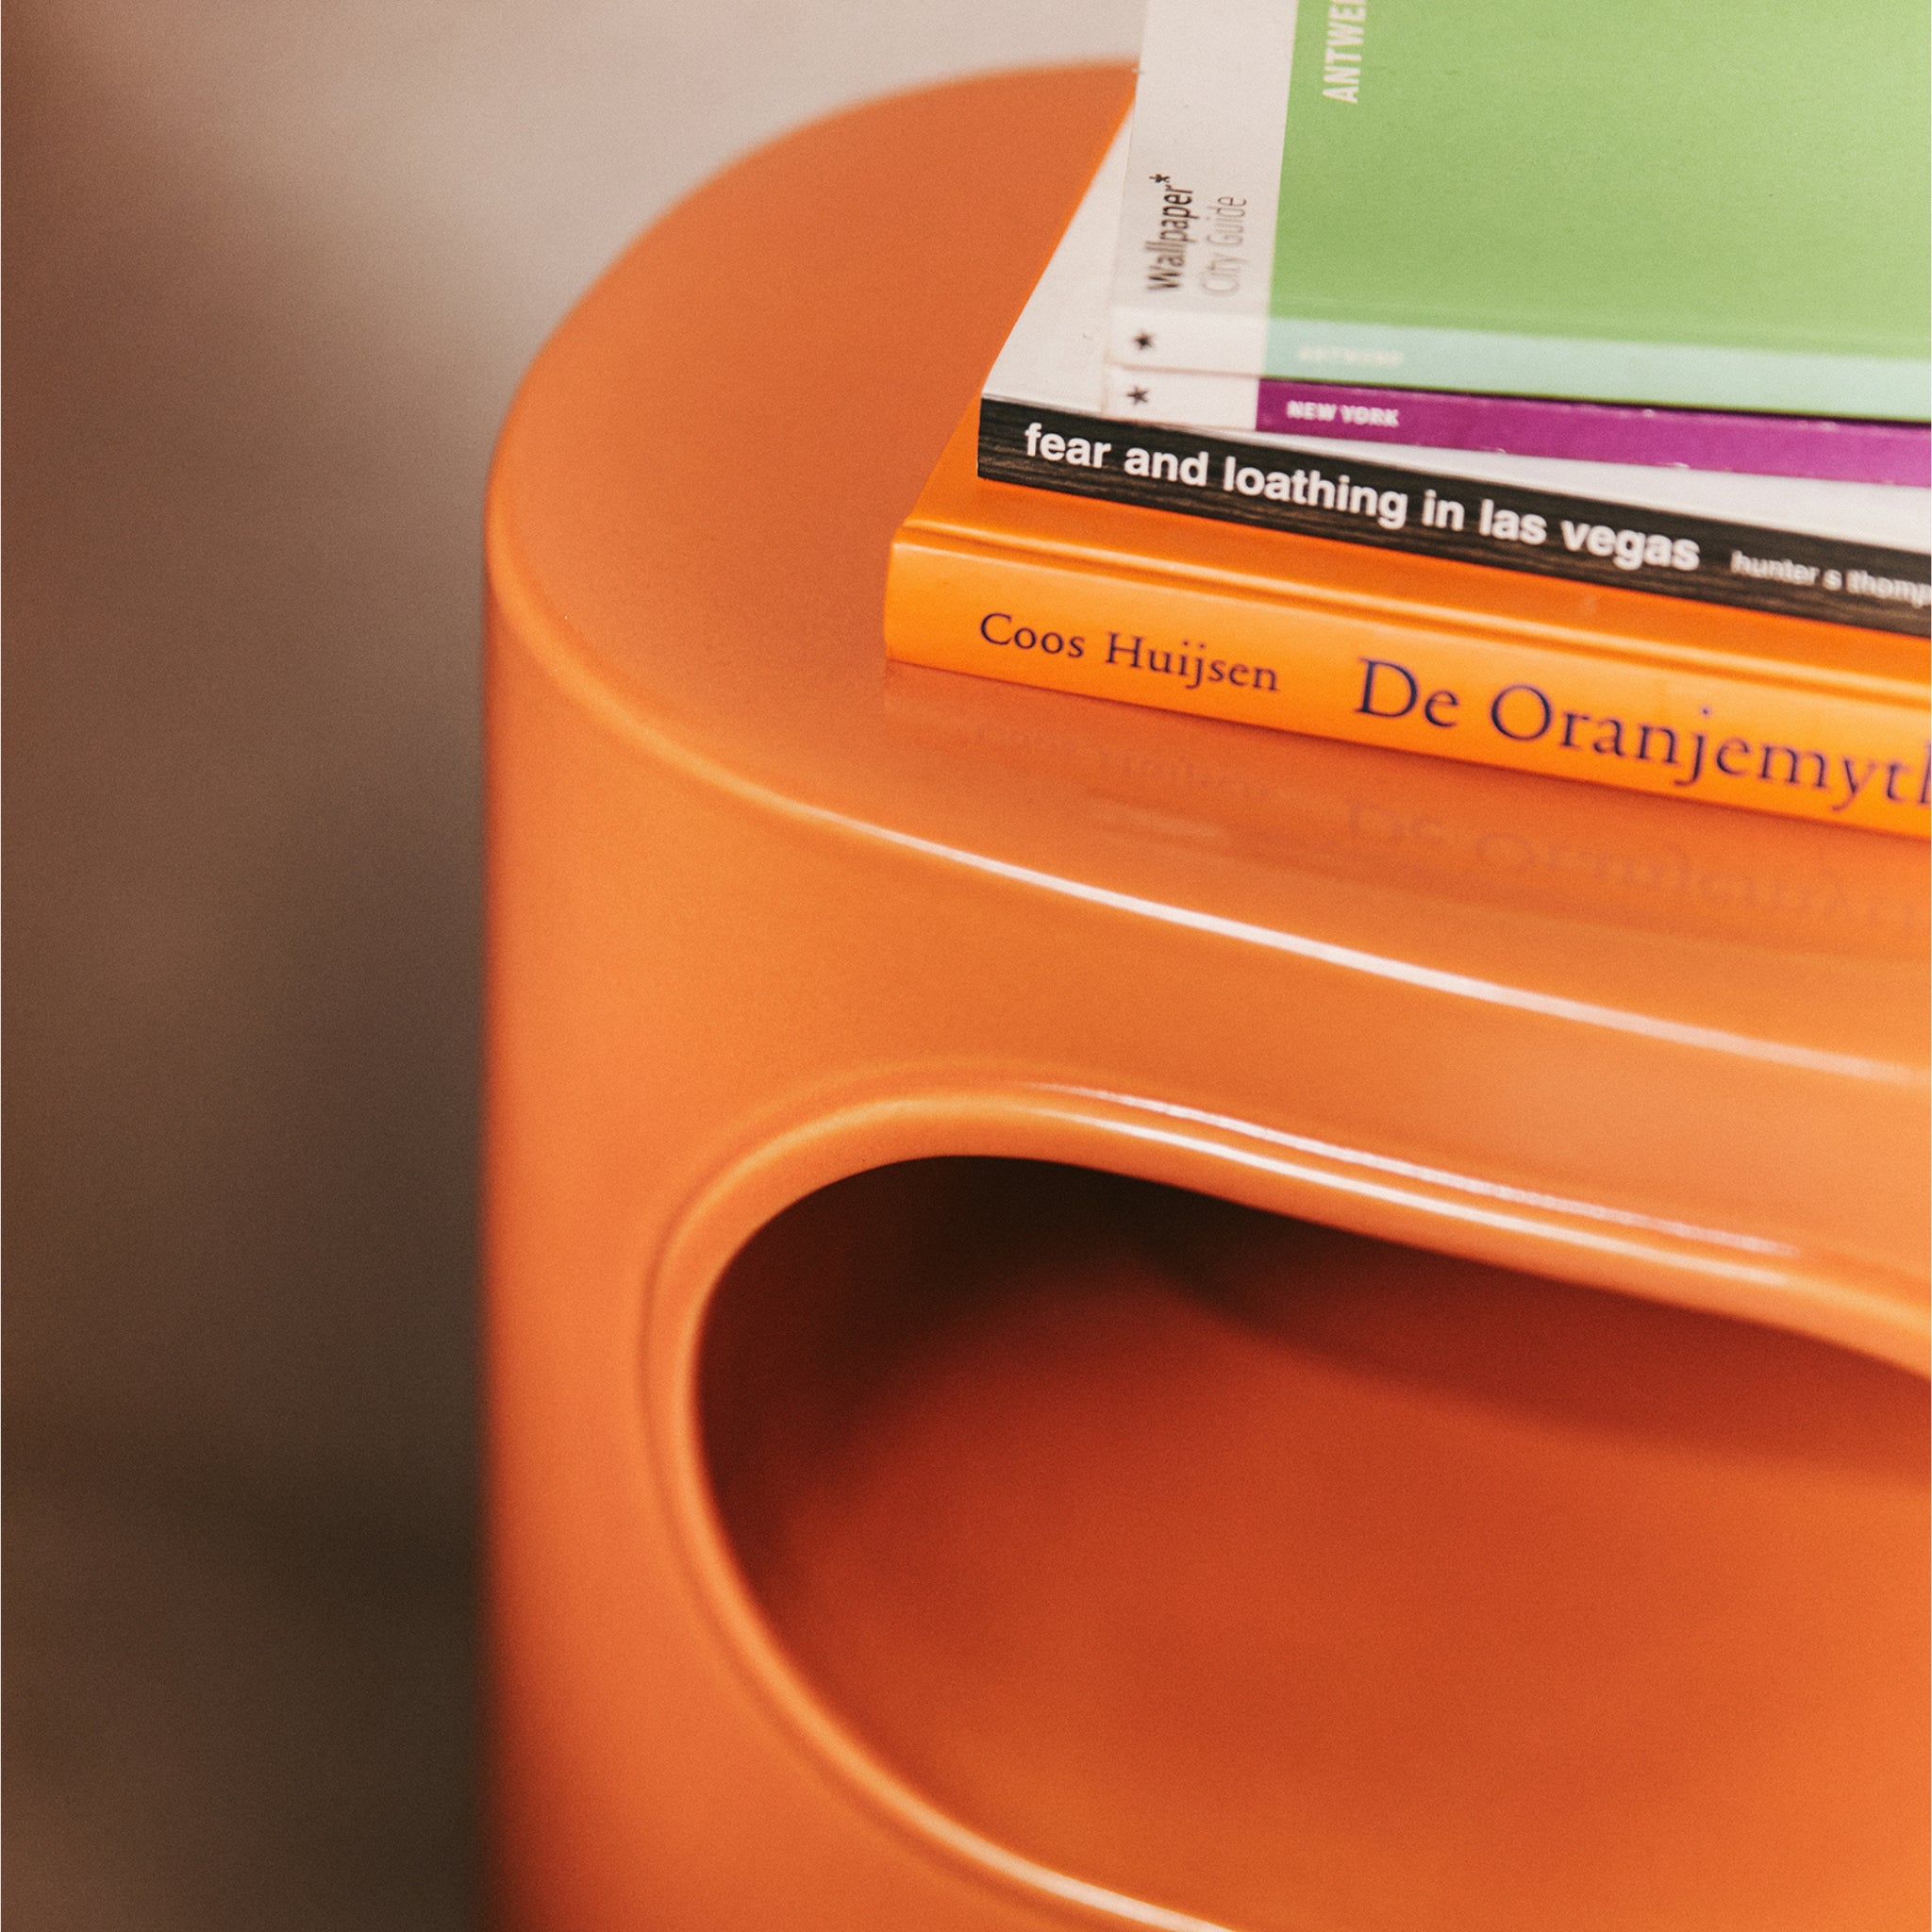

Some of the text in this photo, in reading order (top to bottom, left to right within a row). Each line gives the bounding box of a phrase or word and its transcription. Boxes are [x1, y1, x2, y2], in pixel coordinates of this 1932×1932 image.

[1198, 195, 1249, 297] City Guide
[1286, 400, 1400, 428] NEW YORK
[1024, 422, 1111, 469] fear
[1124, 446, 1209, 488] and
[1223, 455, 1408, 530] loathing
[1423, 489, 1465, 531] in
[1479, 498, 1548, 545] las
[1560, 519, 1701, 571] vegas
[1731, 550, 1821, 587] hunter
[1823, 568, 1842, 591] s
[979, 612, 1086, 658] Coos
[1105, 631, 1280, 692] Huijsen
[1356, 657, 1460, 728] De
